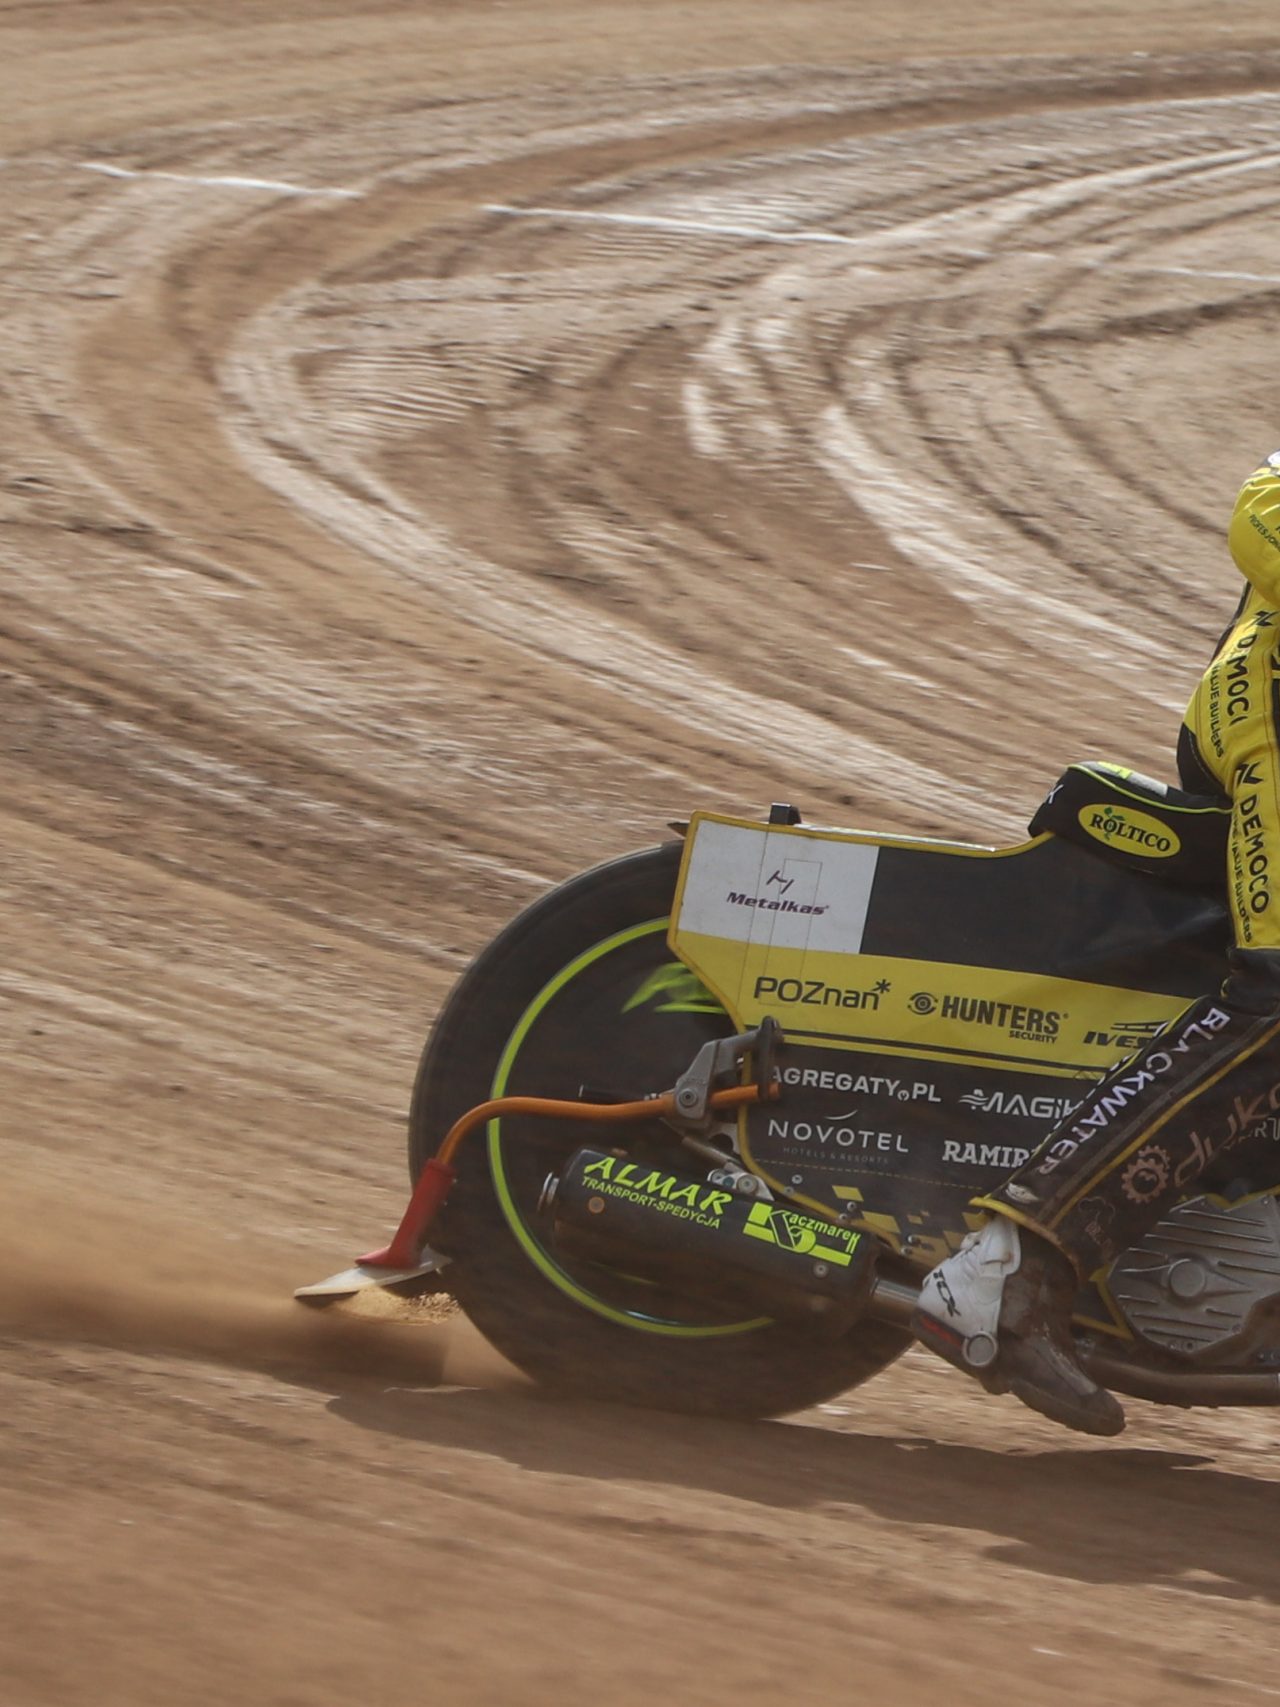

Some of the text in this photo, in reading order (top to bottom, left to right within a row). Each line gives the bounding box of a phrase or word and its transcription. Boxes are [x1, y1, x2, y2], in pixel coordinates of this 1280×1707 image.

[1226, 634, 1257, 726] DMOC
[1089, 812, 1171, 852] ROLTICO
[1240, 794, 1270, 914] DEMOCO
[726, 890, 827, 917] Metalkas
[941, 995, 1060, 1034] HUNTERS
[1009, 1029, 1058, 1044] SECURITY
[768, 1119, 909, 1153] NOVOTEL
[943, 1140, 1032, 1169] RAMIR
[580, 1176, 721, 1230] TRANSPORT-SPEDYCJA
[584, 1156, 734, 1216] ALMAR
